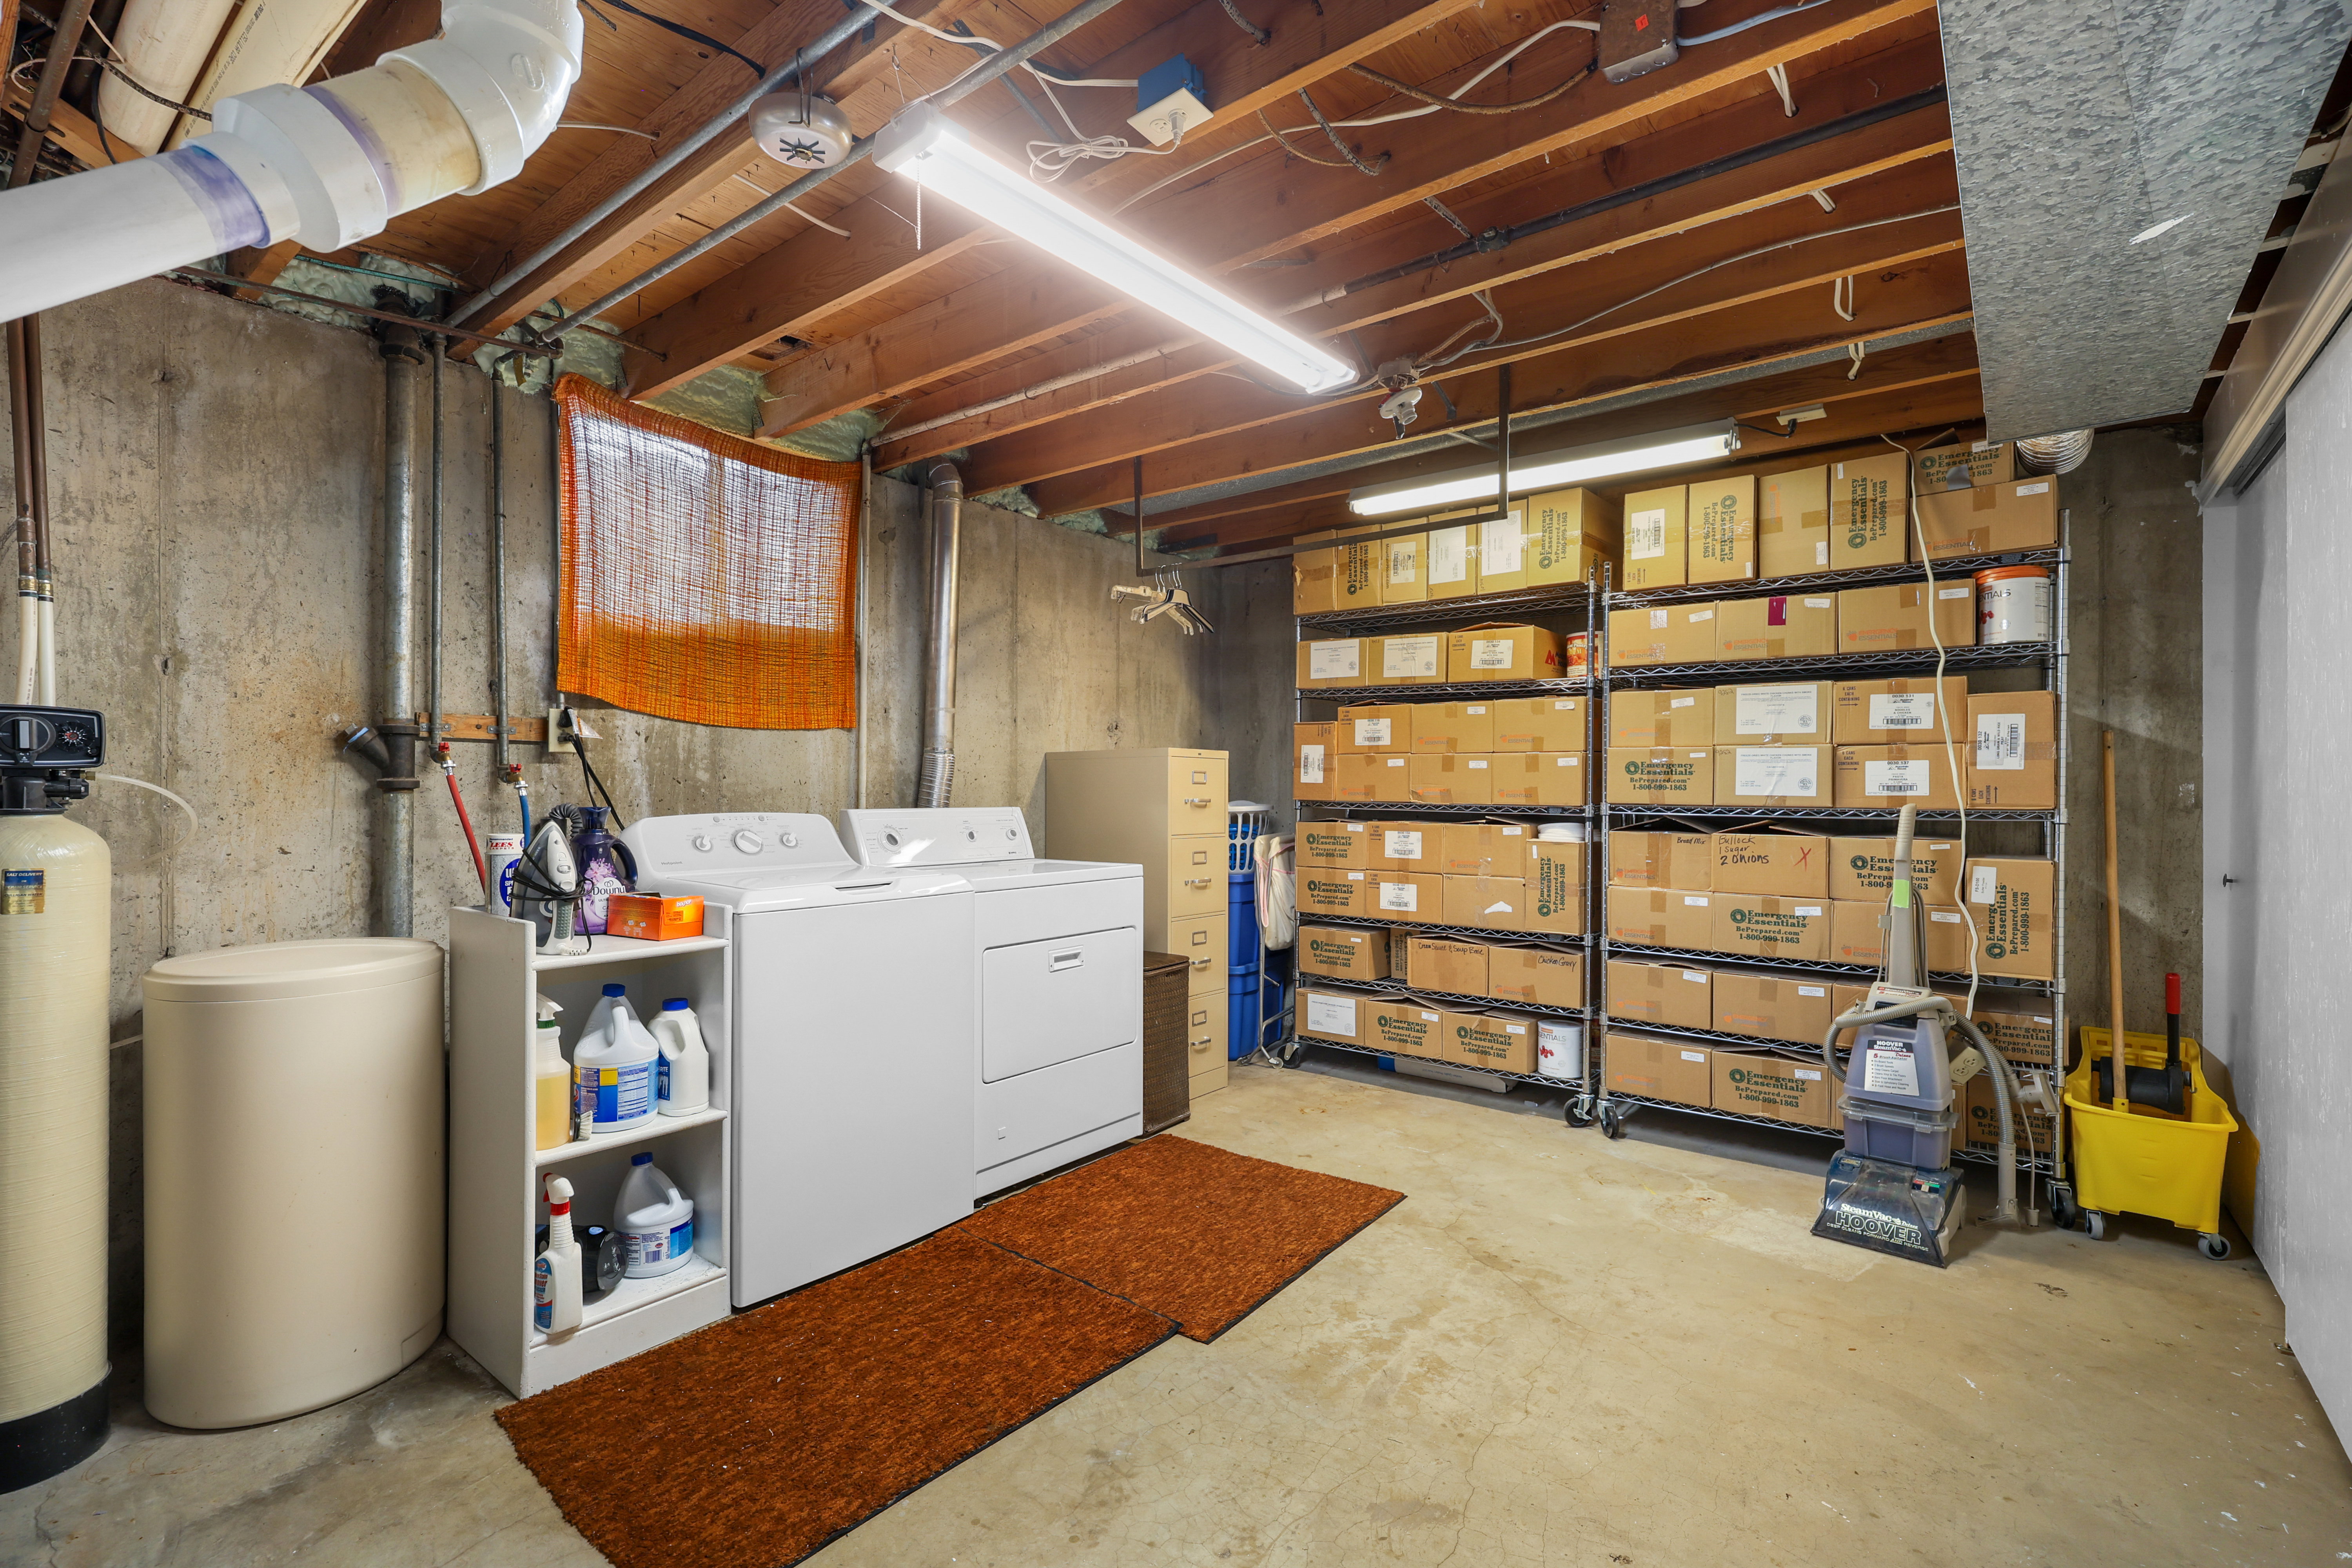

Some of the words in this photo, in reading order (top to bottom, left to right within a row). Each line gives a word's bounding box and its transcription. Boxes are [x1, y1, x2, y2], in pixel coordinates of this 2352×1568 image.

[1849, 479, 1859, 533] Emergency
[1879, 480, 1887, 536] 1-800-999-1863
[1641, 761, 1694, 770] Emergency
[1719, 835, 1756, 845] Bullock
[1720, 856, 1728, 866] 2
[1870, 856, 1937, 867] Emeency
[593, 886, 626, 895] Downy
[2021, 892, 2029, 951] 1-800-999-1863
[1739, 933, 1800, 944] 1-800-999-1863
[1320, 941, 1355, 950] Emergency
[1454, 946, 1468, 955] Soup
[1315, 959, 1351, 967] 1-800-999-1863
[1538, 955, 1558, 965] Chicken
[1558, 958, 1577, 972] Gravy
[1389, 1017, 1427, 1028] Emergency
[1469, 1027, 1512, 1040] Emergency
[1383, 1035, 1423, 1046] 1-800-999-1863
[1463, 1046, 1506, 1059] 1-800-999-1863
[1747, 1071, 1806, 1086] Emergency
[1739, 1093, 1799, 1108] 1-800-999-1863
[1841, 1203, 1892, 1221] SteamVac
[1900, 1220, 1918, 1229] Deluxe
[1835, 1210, 1921, 1245] HOOVER
[1841, 1226, 1862, 1235] CLEANS
[1863, 1232, 1890, 1241] FORWARD
[1904, 1242, 1929, 1251] REVERSE
